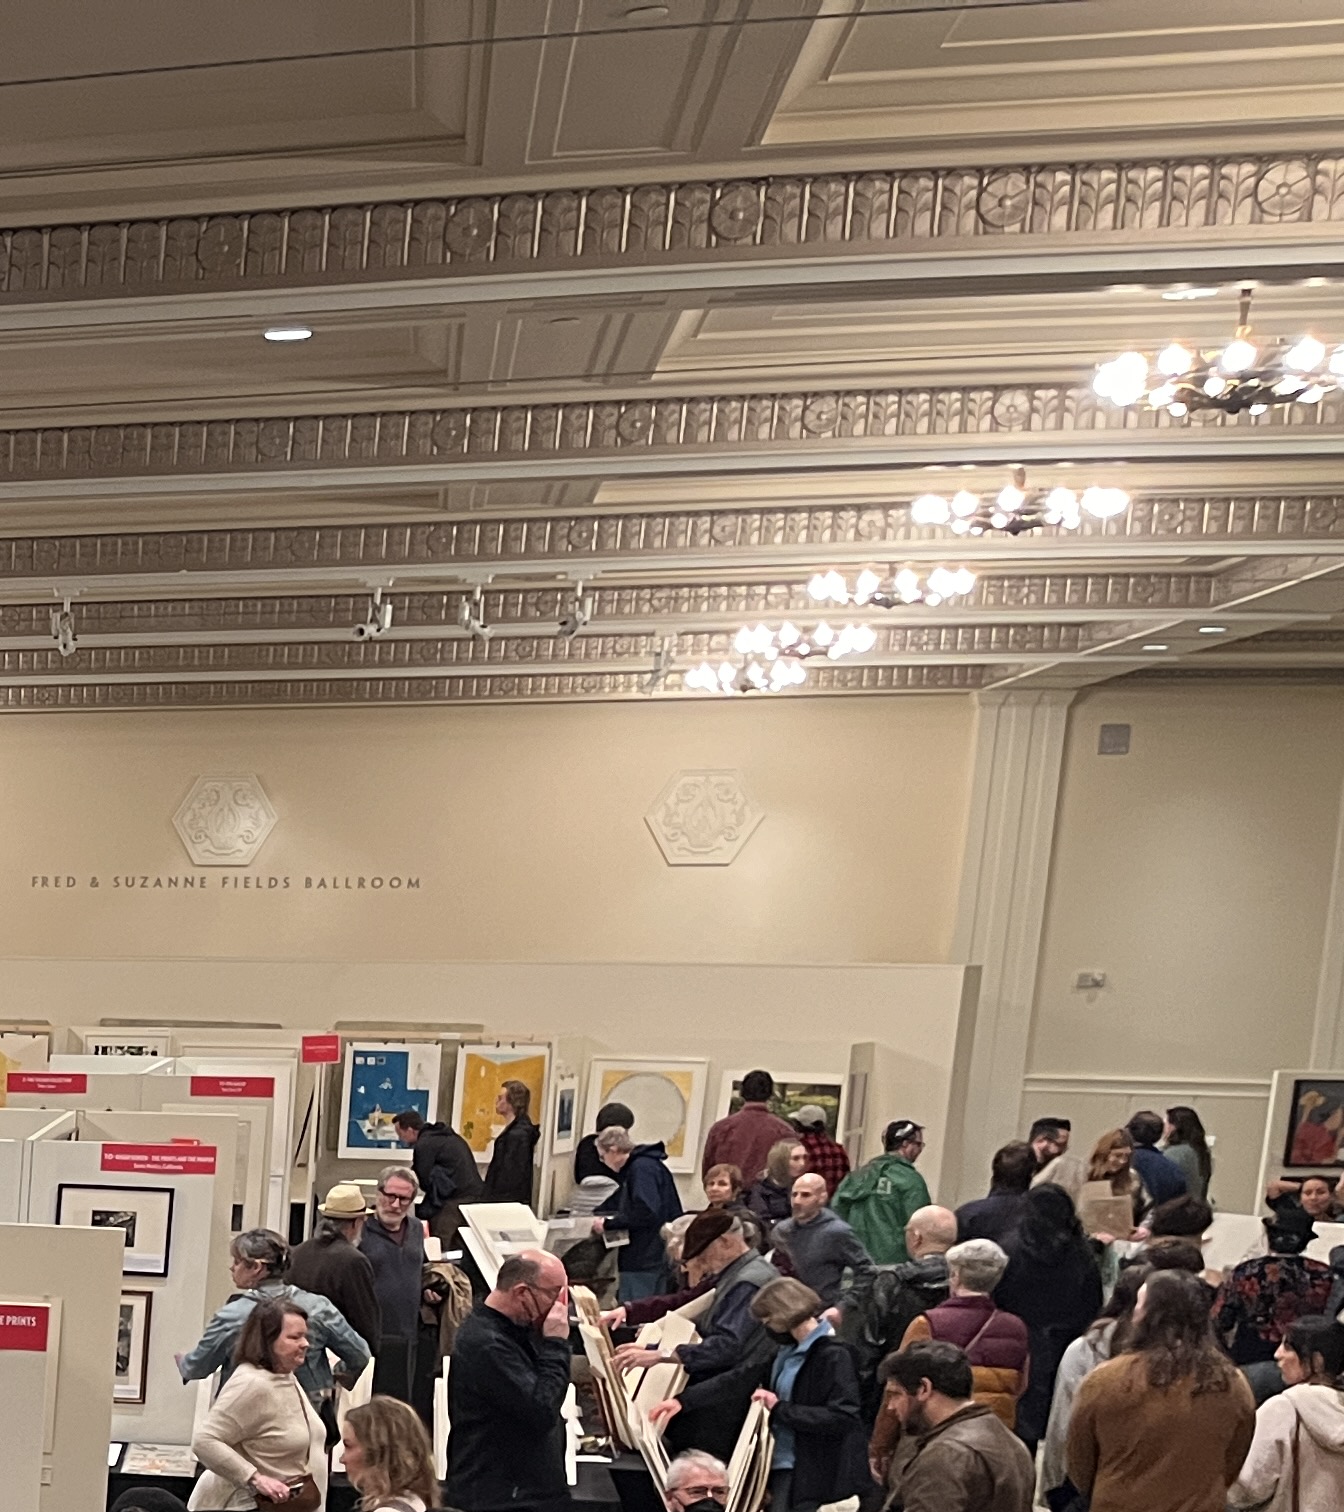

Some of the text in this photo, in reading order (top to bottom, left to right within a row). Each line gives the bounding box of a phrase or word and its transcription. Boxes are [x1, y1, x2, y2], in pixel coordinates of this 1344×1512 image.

[31, 875, 421, 889] FRED & SUZANNE FIELDS BALLROOM
[6, 1316, 37, 1327] PRINTS
